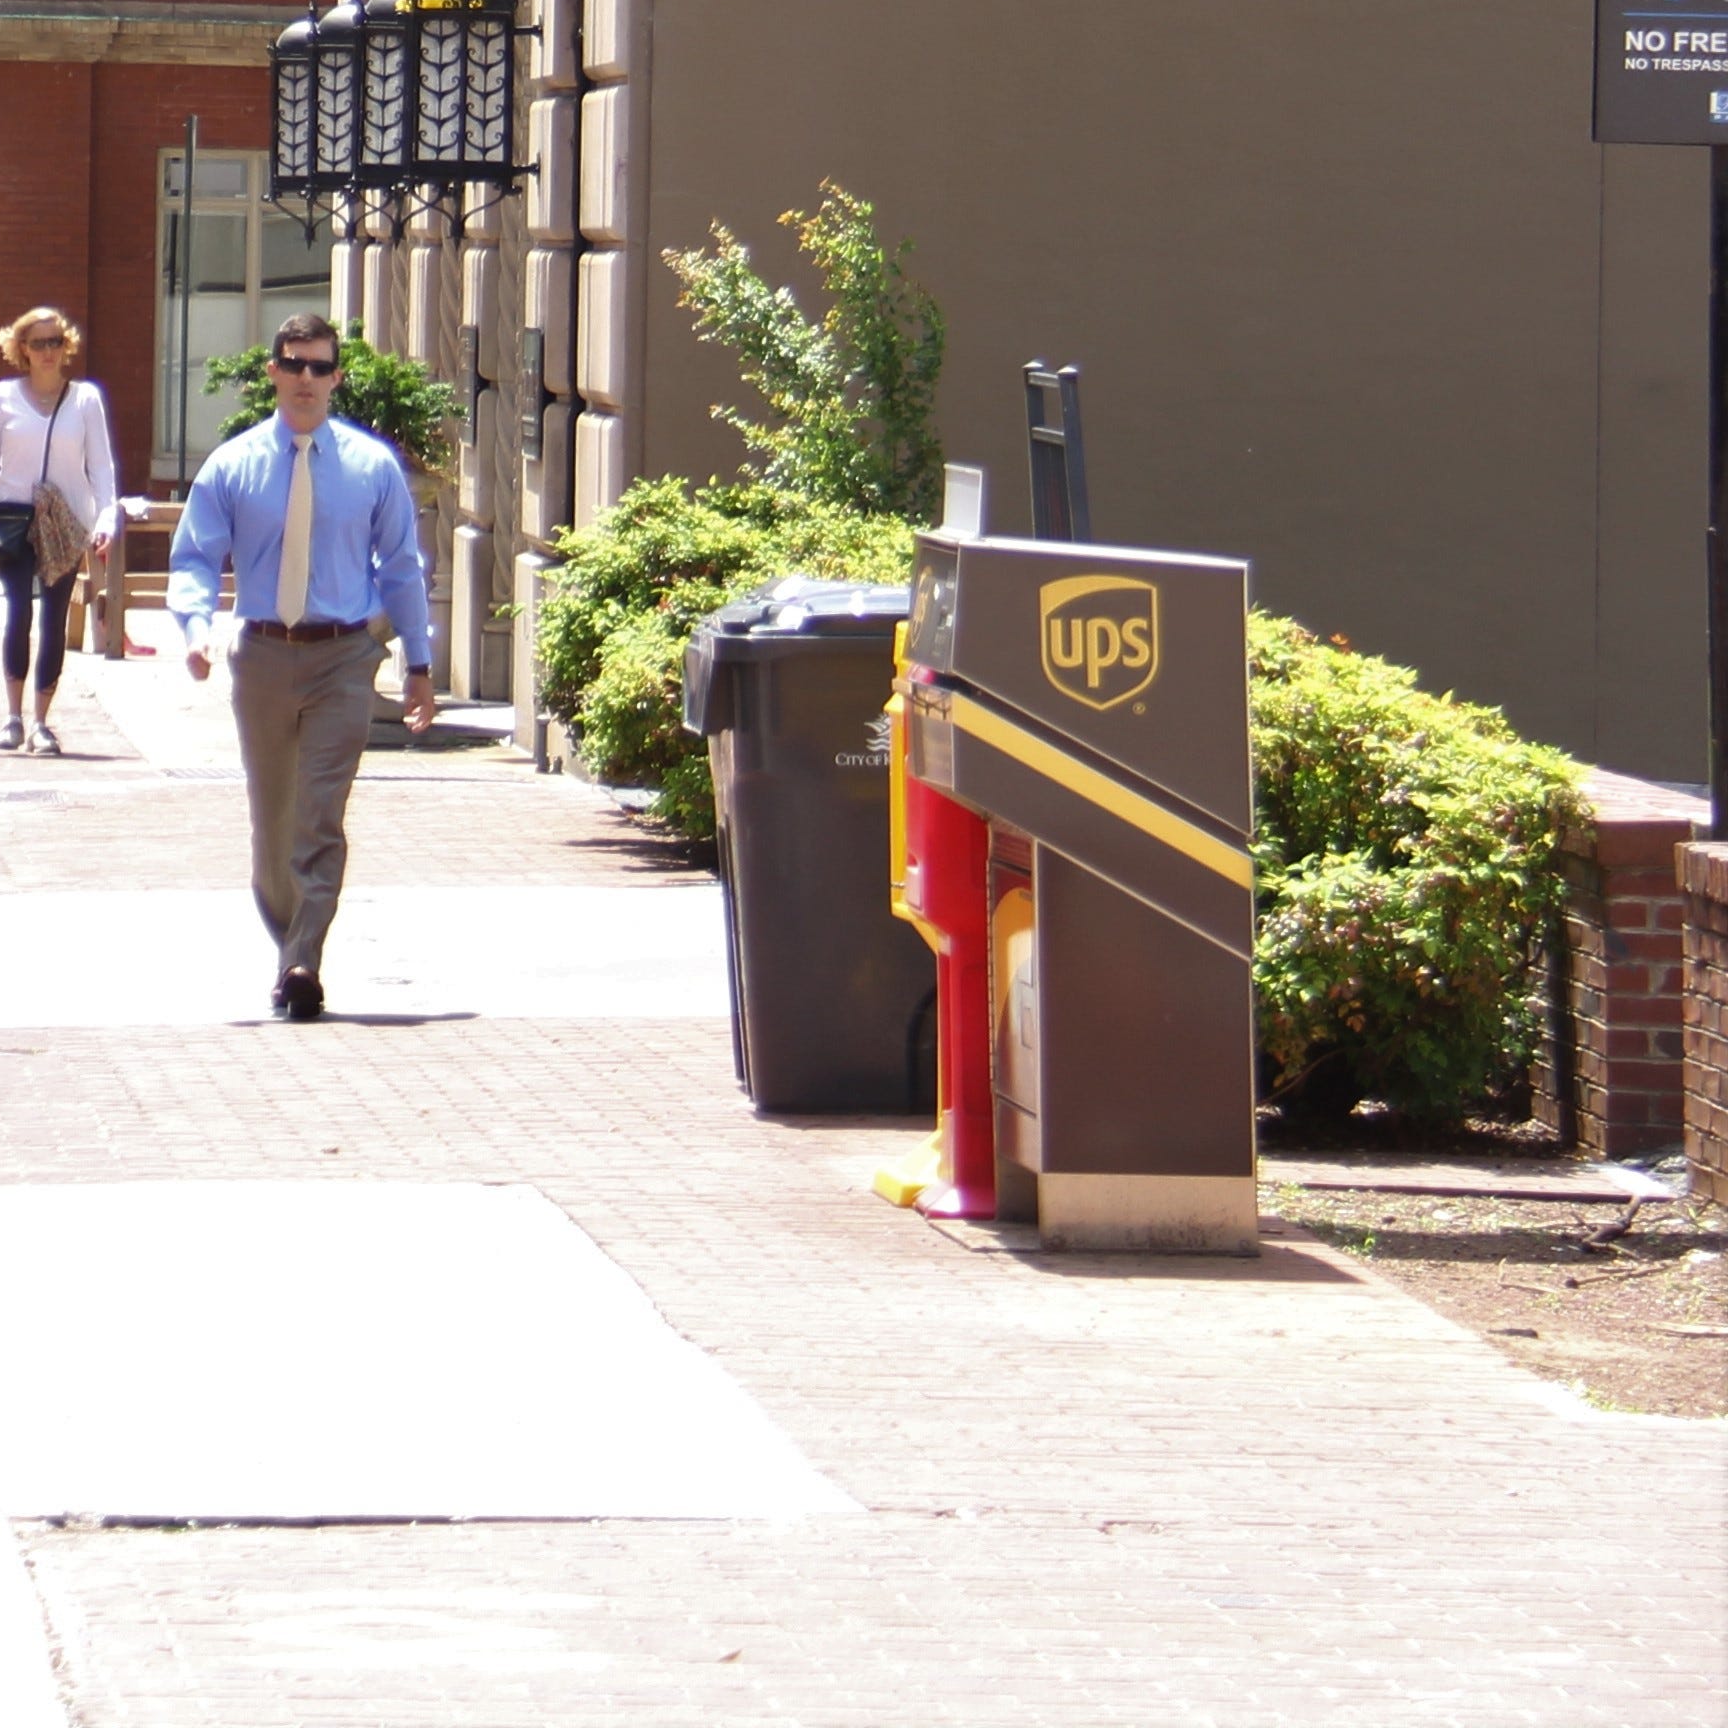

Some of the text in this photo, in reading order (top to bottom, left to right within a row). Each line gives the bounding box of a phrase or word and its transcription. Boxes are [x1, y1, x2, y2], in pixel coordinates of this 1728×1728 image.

[1625, 30, 1666, 51] NO
[1625, 58, 1648, 70] NO
[1050, 617, 1149, 688] ups
